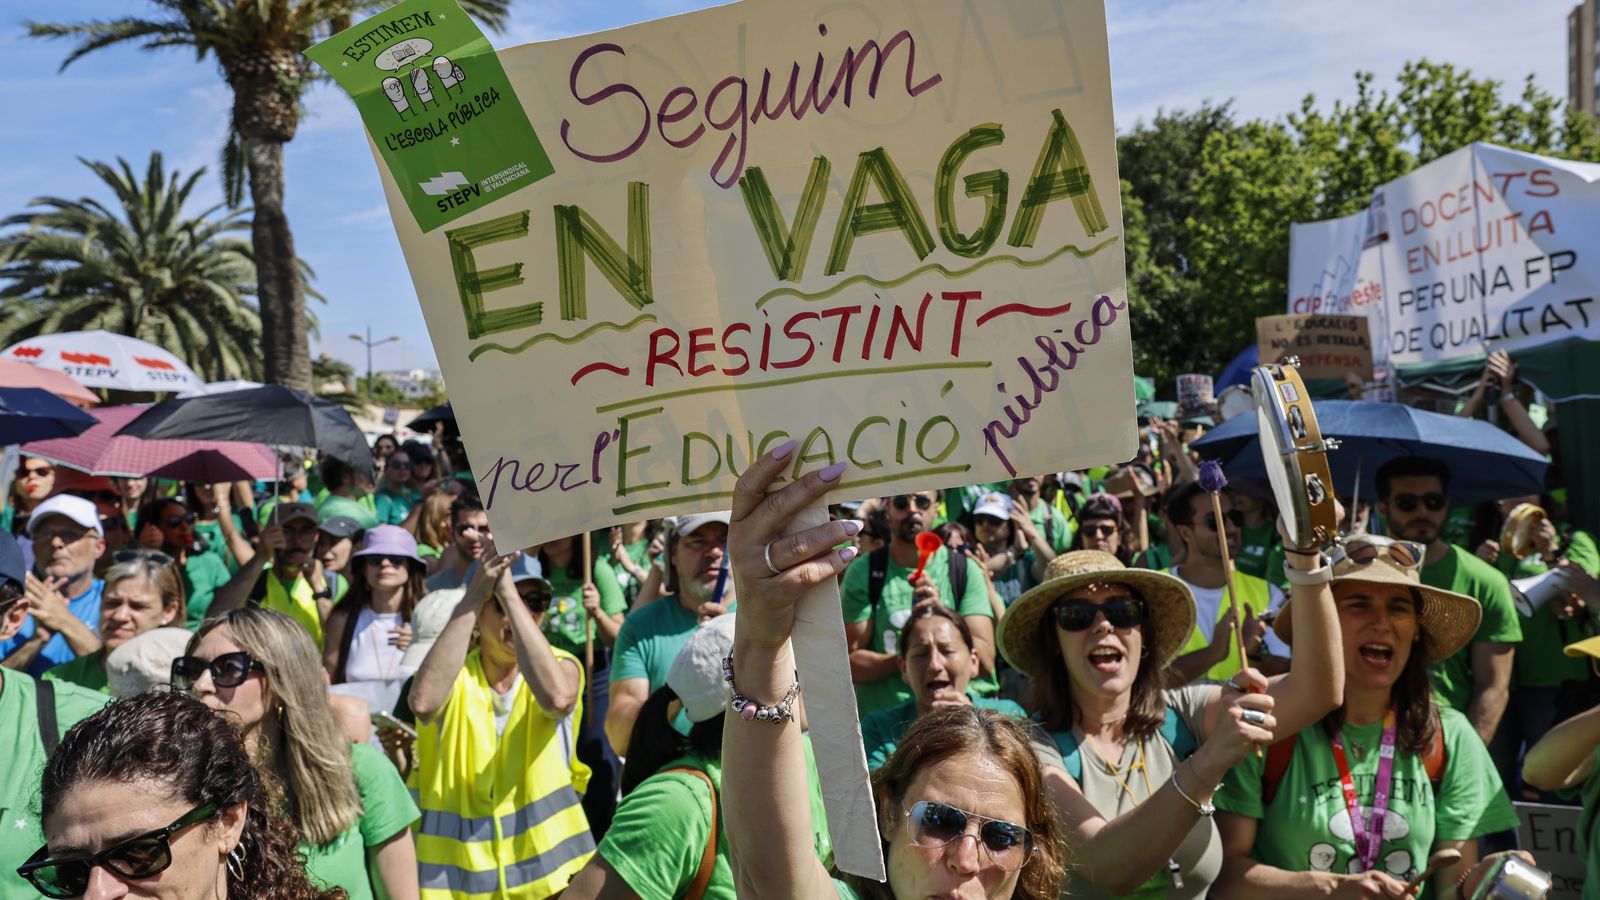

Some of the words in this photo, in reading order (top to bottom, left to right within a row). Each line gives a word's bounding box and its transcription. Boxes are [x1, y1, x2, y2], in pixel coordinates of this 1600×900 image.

[342, 10, 436, 63] ESTIMEM
[560, 23, 943, 190] Seguim
[384, 117, 449, 152] L'ESCOLA
[436, 183, 481, 213] STEPV
[480, 161, 528, 187] INTERSINDICAL
[491, 167, 530, 191] VALENCIANA
[444, 180, 654, 340] EN
[739, 108, 1110, 283] VAGA
[1400, 169, 1560, 236] DOCENTS
[1407, 240, 1441, 275] EN
[1446, 209, 1556, 263] LLUITA
[1398, 281, 1446, 315] PER
[1451, 265, 1514, 304] UNA
[1524, 250, 1577, 289] FP
[1392, 326, 1423, 355] DE
[1429, 298, 1594, 350] QUALITAT
[64, 366, 119, 379] STEPV
[148, 371, 188, 382] STEPV
[982, 293, 1126, 478] pública
